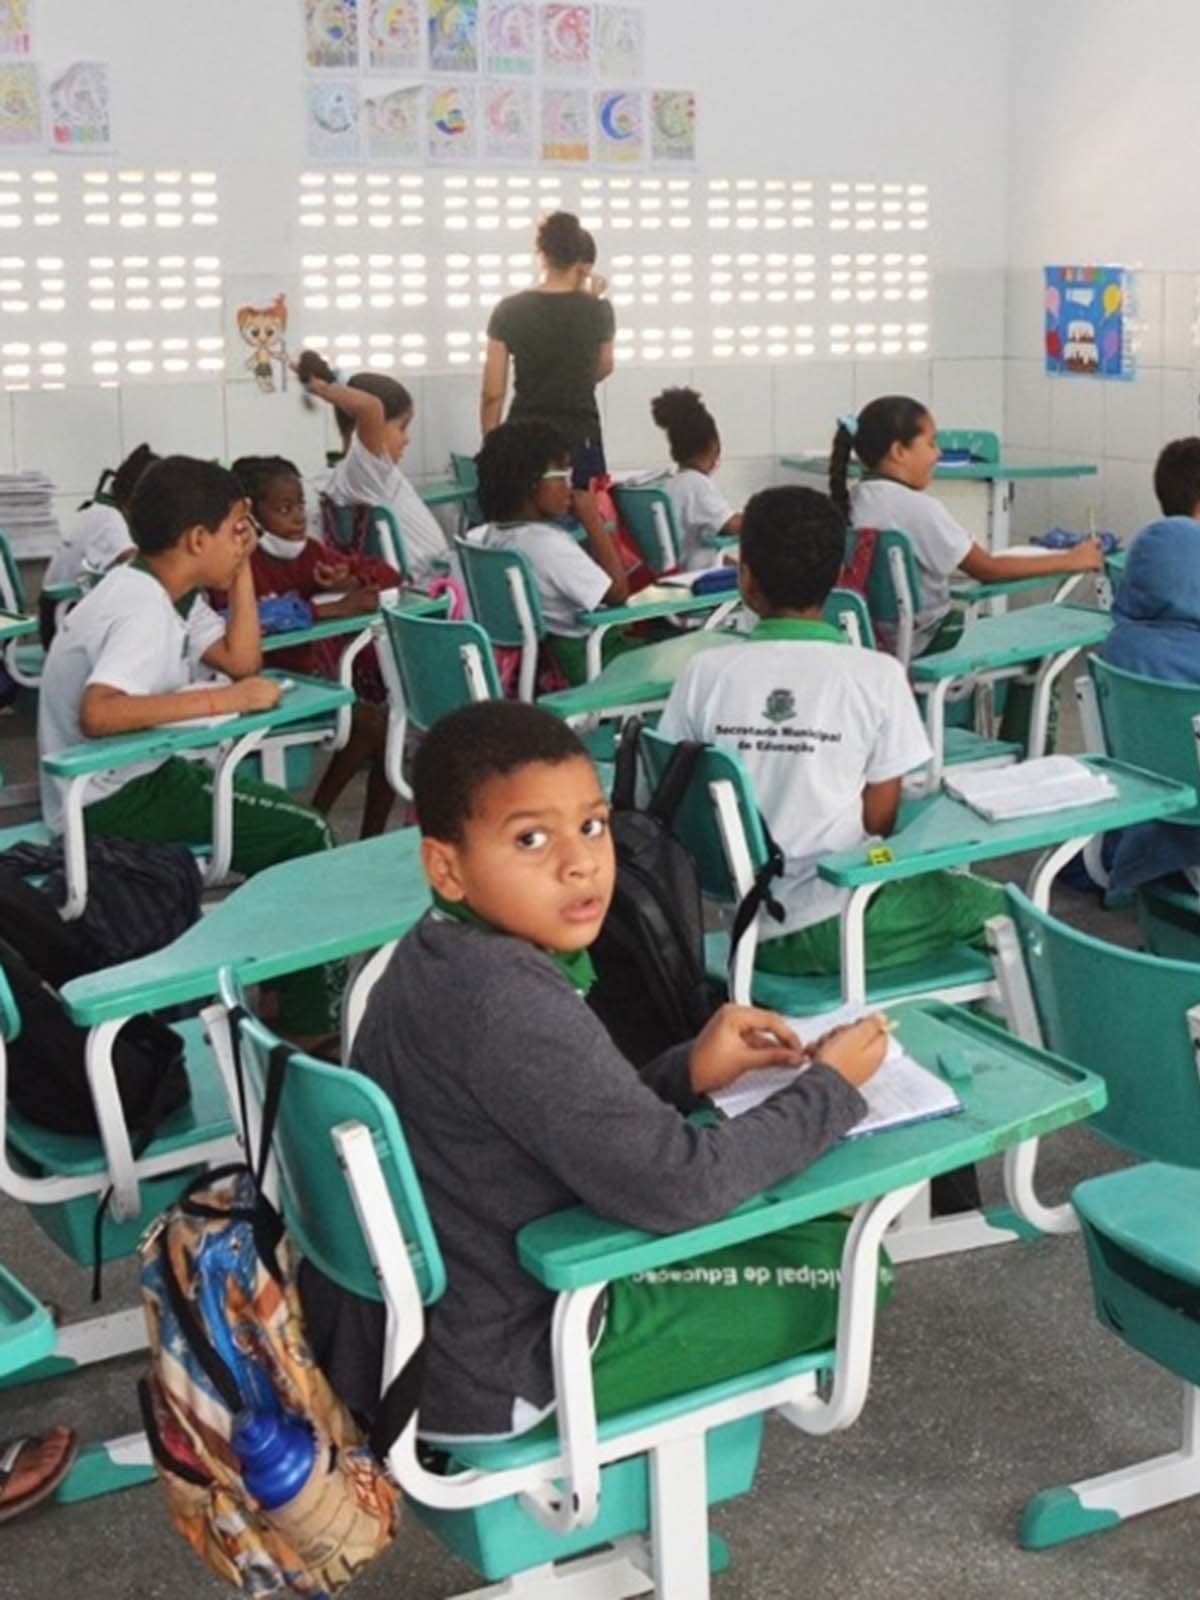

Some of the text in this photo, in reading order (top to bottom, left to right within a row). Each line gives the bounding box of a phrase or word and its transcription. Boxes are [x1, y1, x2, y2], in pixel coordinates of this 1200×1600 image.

[715, 725, 842, 742] Secretaria Municipal
[737, 741, 815, 754] de Educação
[743, 1266, 771, 1288] de
